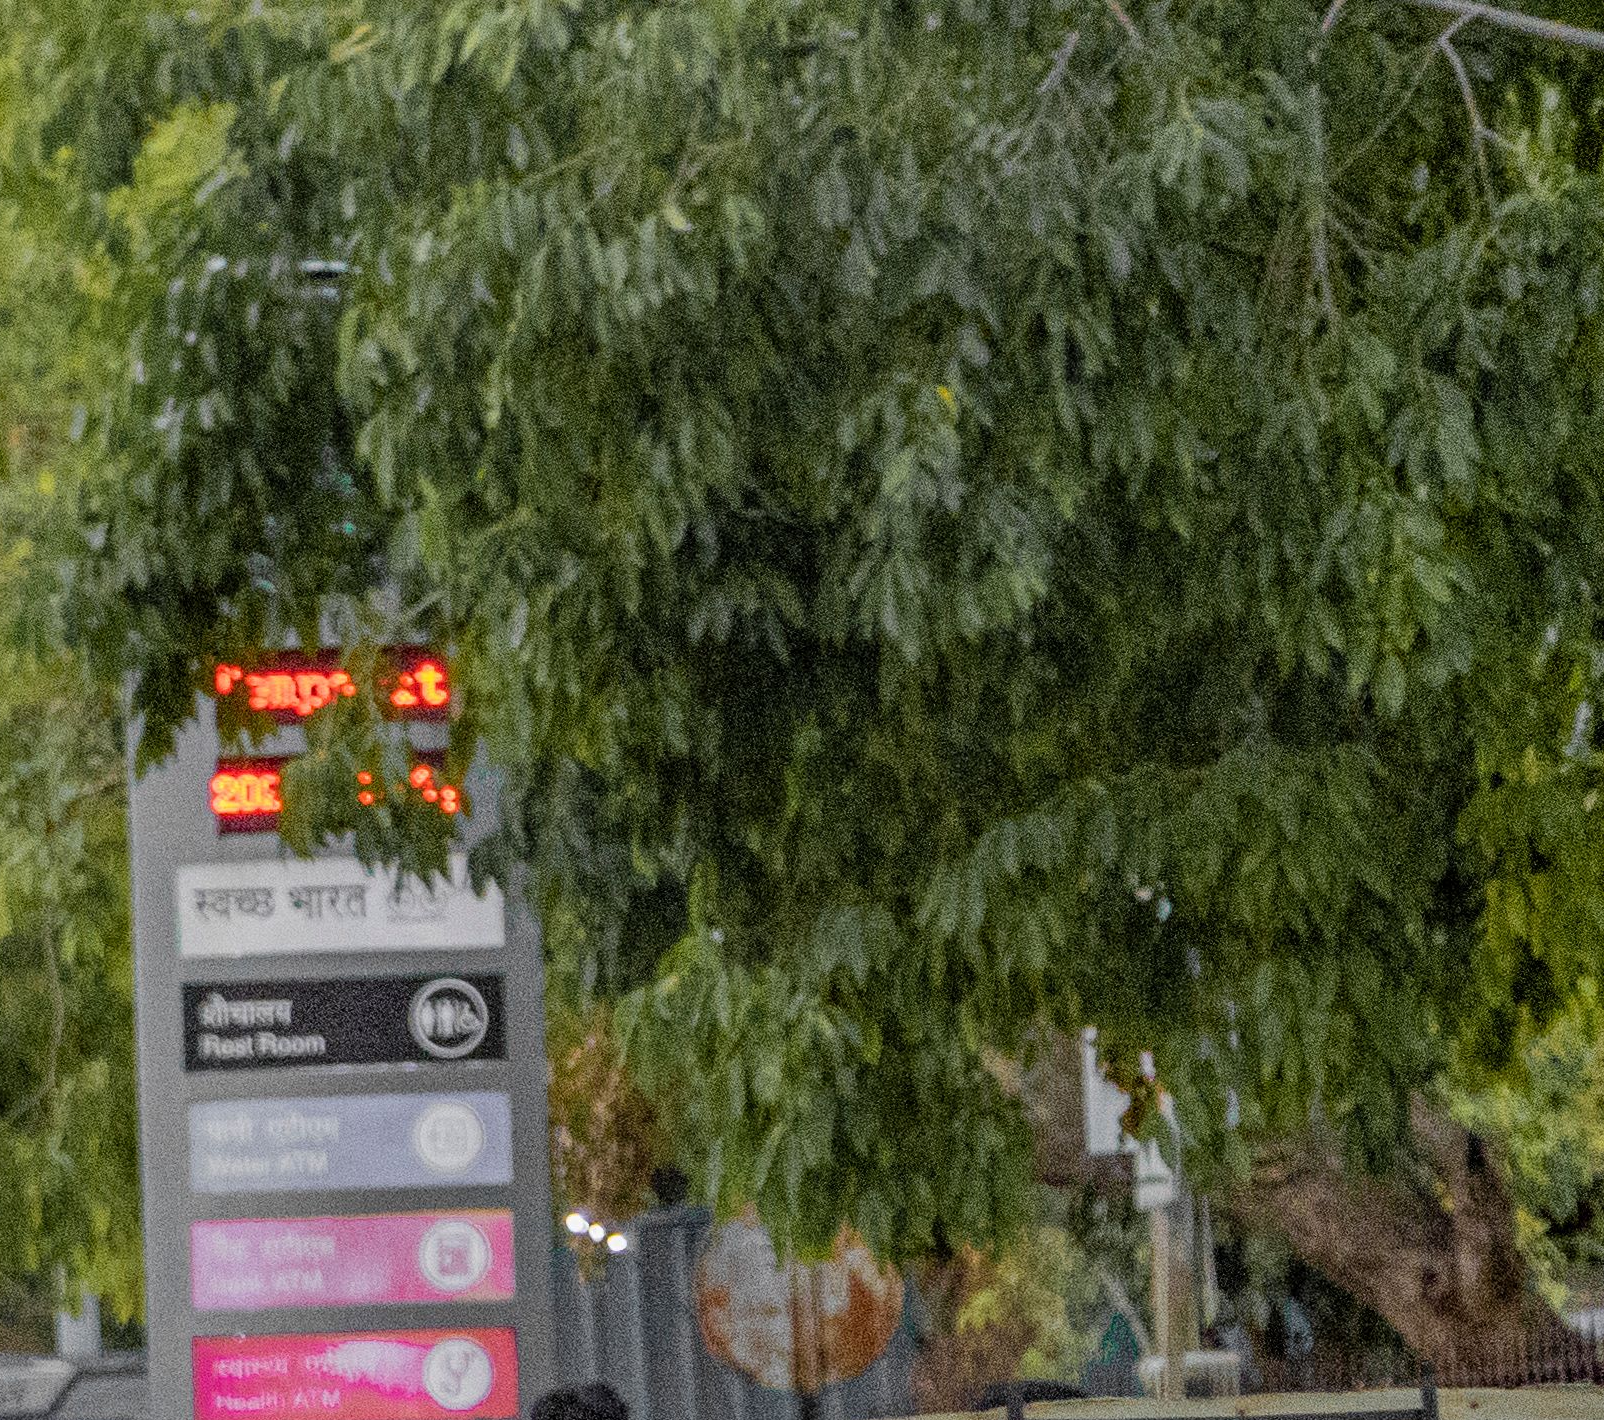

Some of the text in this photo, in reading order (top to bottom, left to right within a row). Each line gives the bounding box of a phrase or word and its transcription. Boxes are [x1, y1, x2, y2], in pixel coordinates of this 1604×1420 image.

[288, 884, 368, 920] भारत
[198, 1031, 326, 1058] Rest Room
